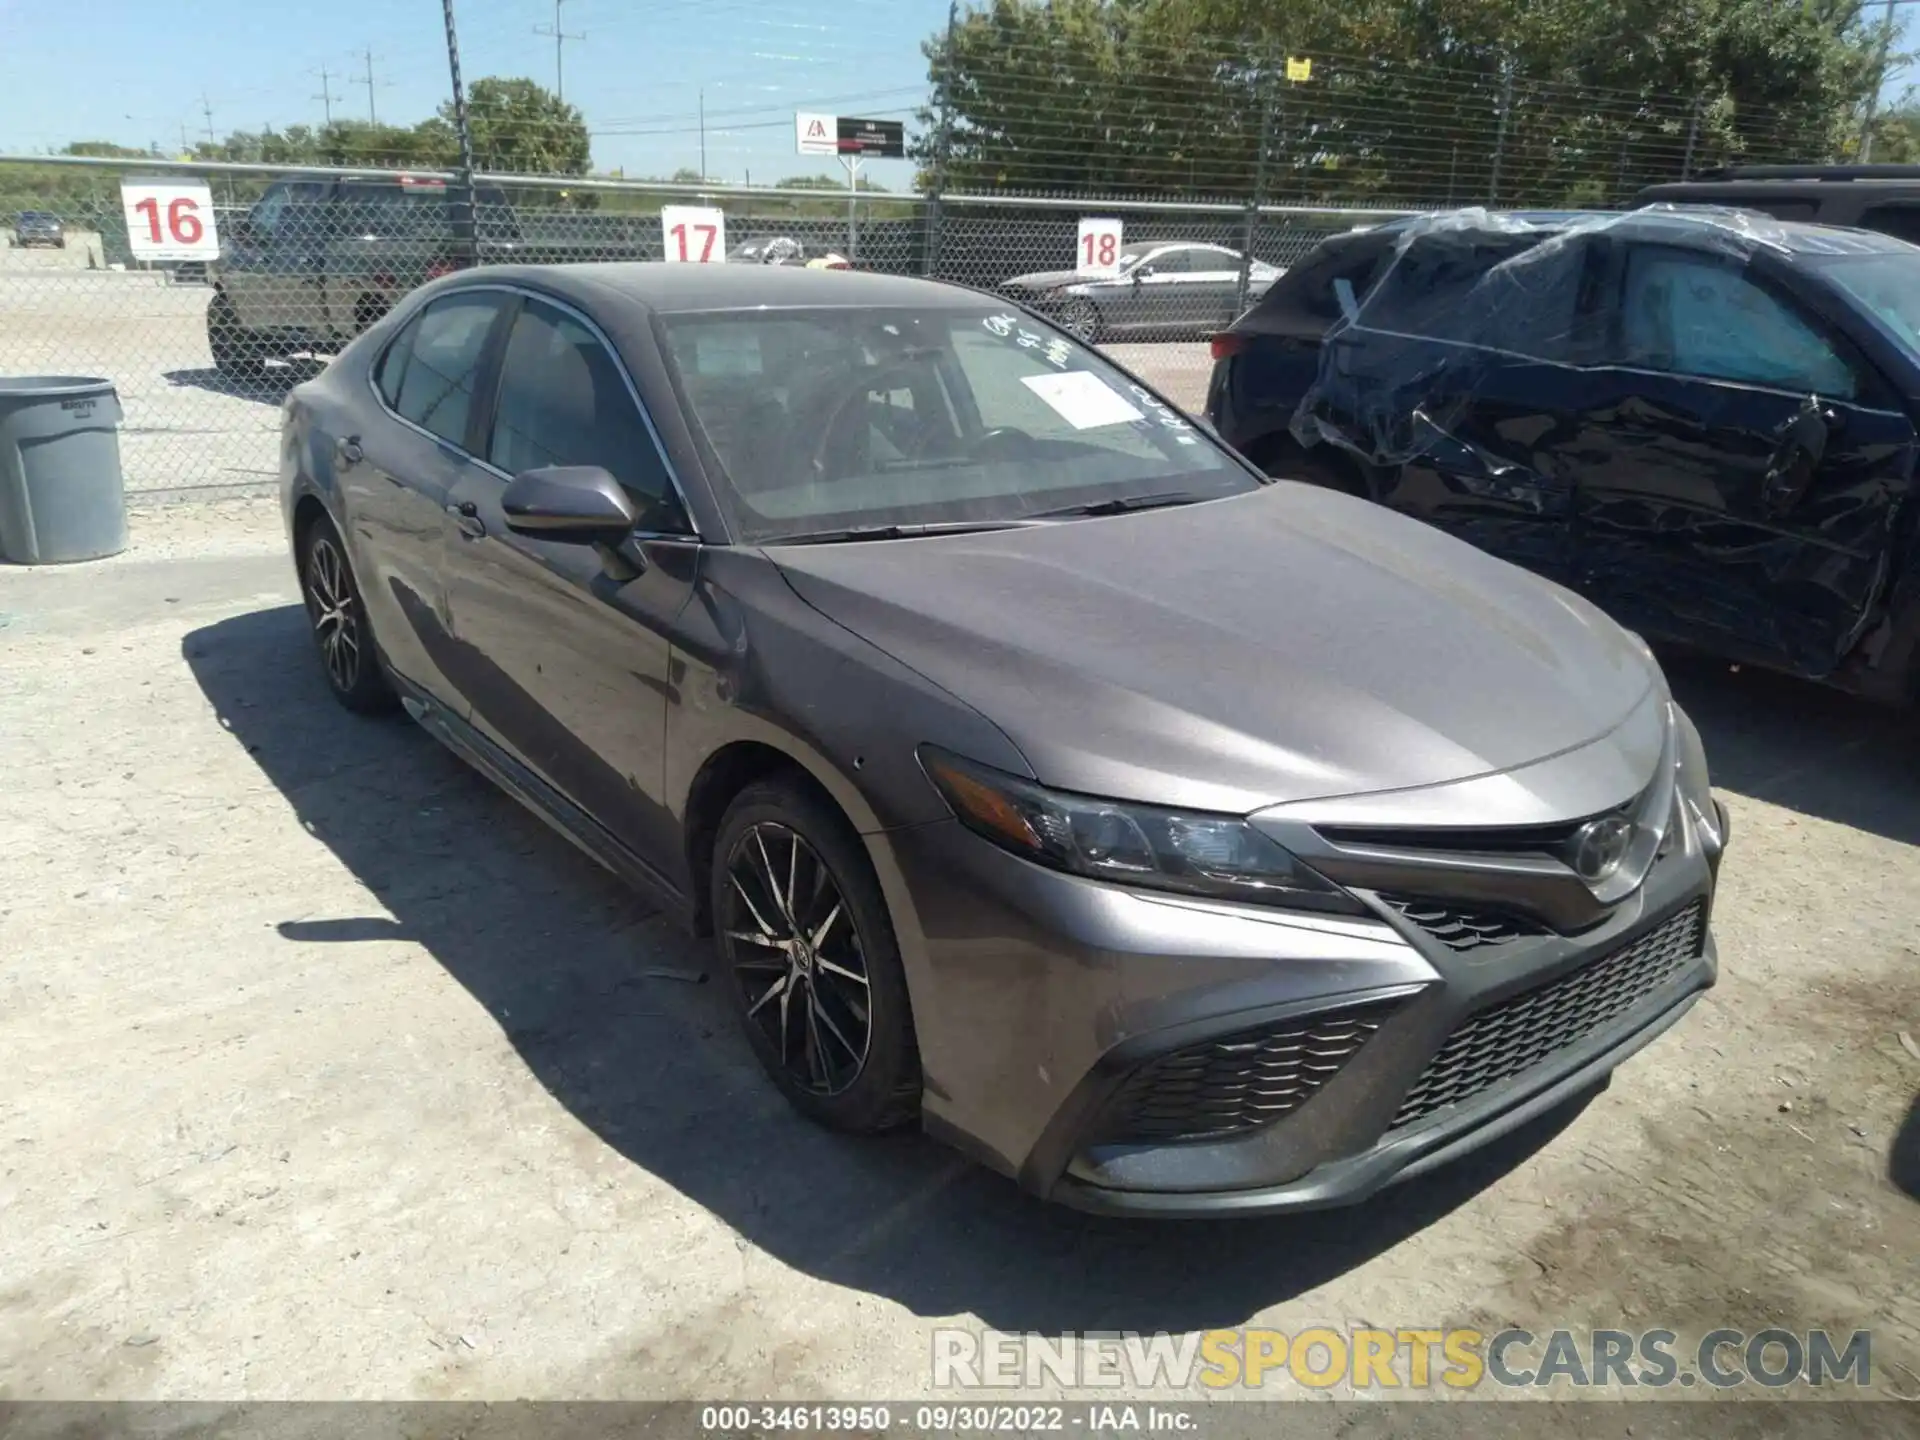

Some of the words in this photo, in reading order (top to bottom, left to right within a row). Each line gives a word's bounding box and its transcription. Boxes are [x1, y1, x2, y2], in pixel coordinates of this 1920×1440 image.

[135, 197, 203, 244] 16
[670, 223, 717, 263] 17
[1082, 232, 1116, 266] 18
